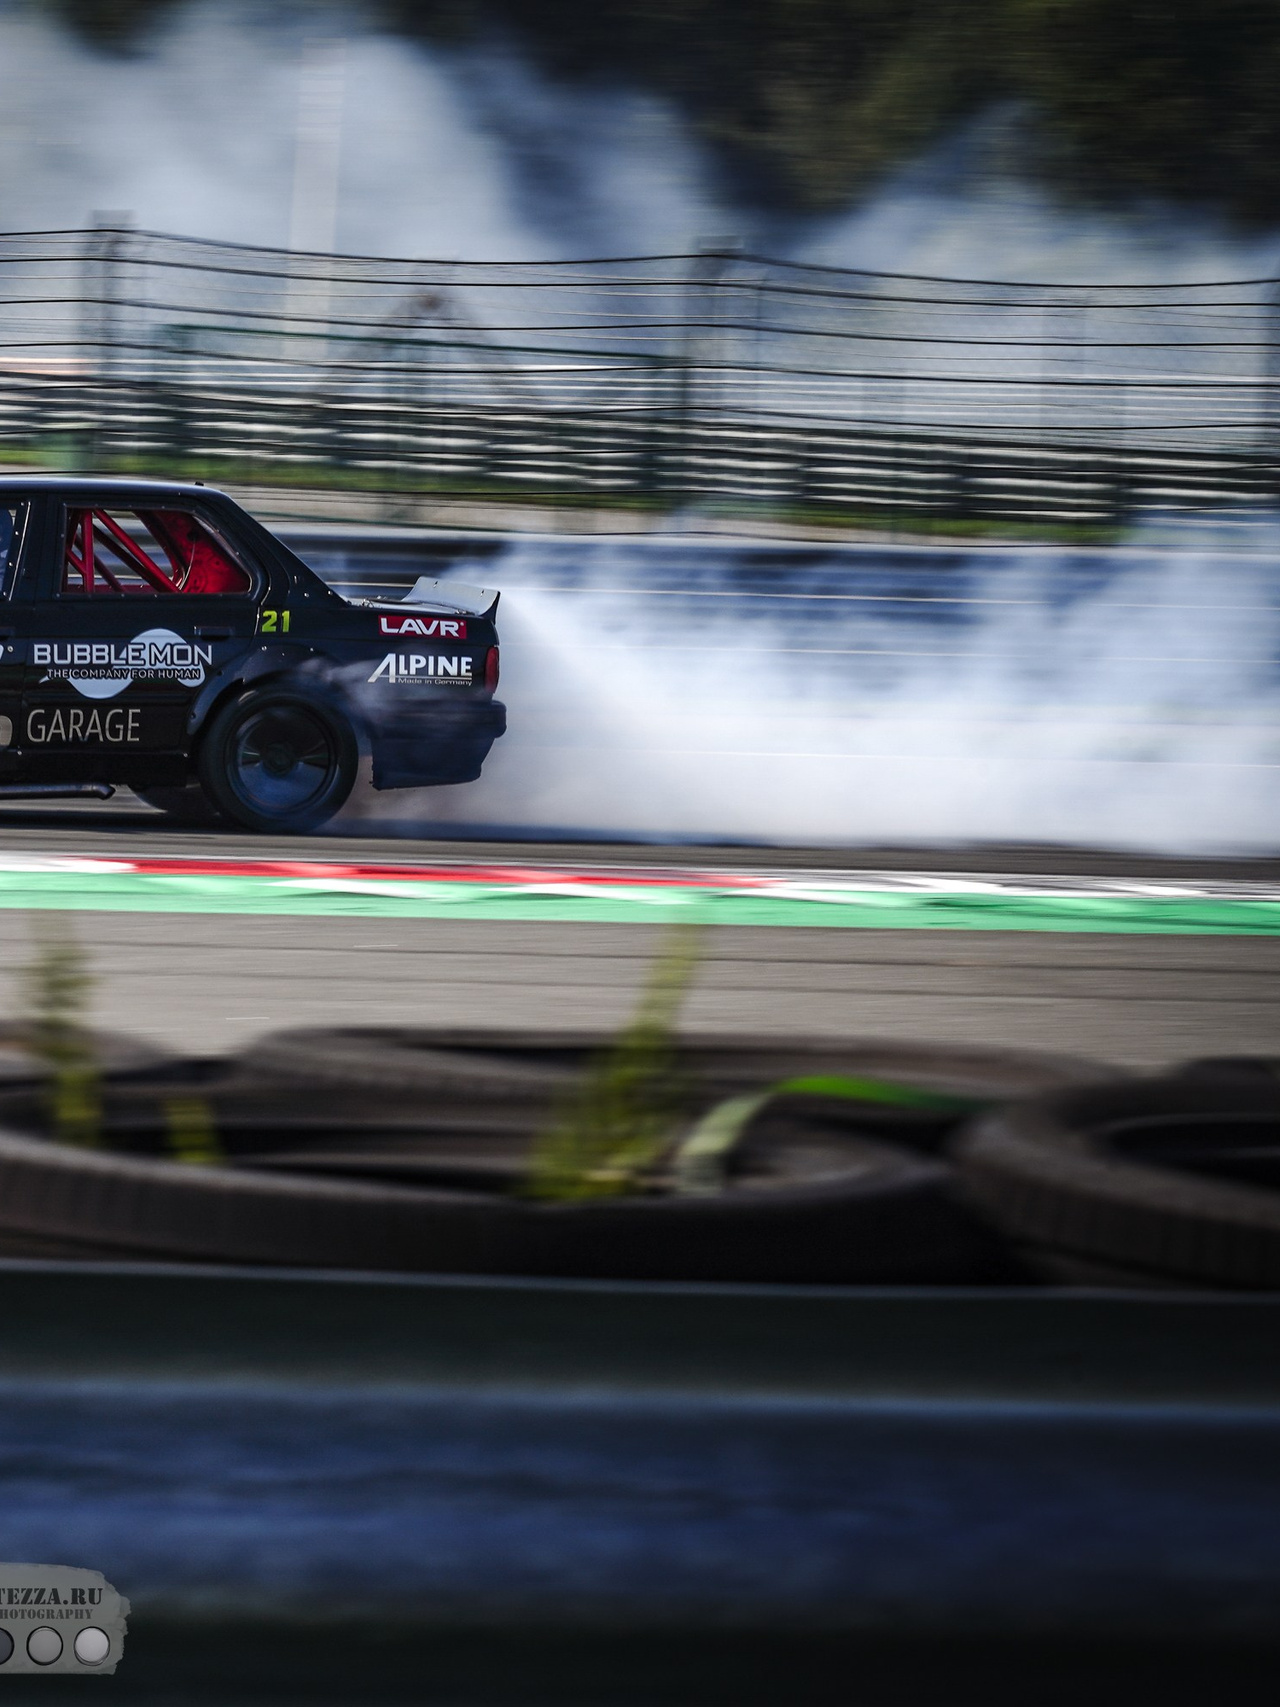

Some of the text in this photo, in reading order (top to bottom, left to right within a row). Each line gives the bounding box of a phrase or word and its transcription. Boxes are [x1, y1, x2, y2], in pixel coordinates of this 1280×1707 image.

[261, 610, 290, 633] 21
[380, 617, 459, 638] LAVR
[47, 669, 201, 679] THE COMPANY FOR HUMAN
[367, 653, 473, 683] ALPINE
[434, 679, 473, 687] Germany
[26, 709, 141, 743] GARAGE
